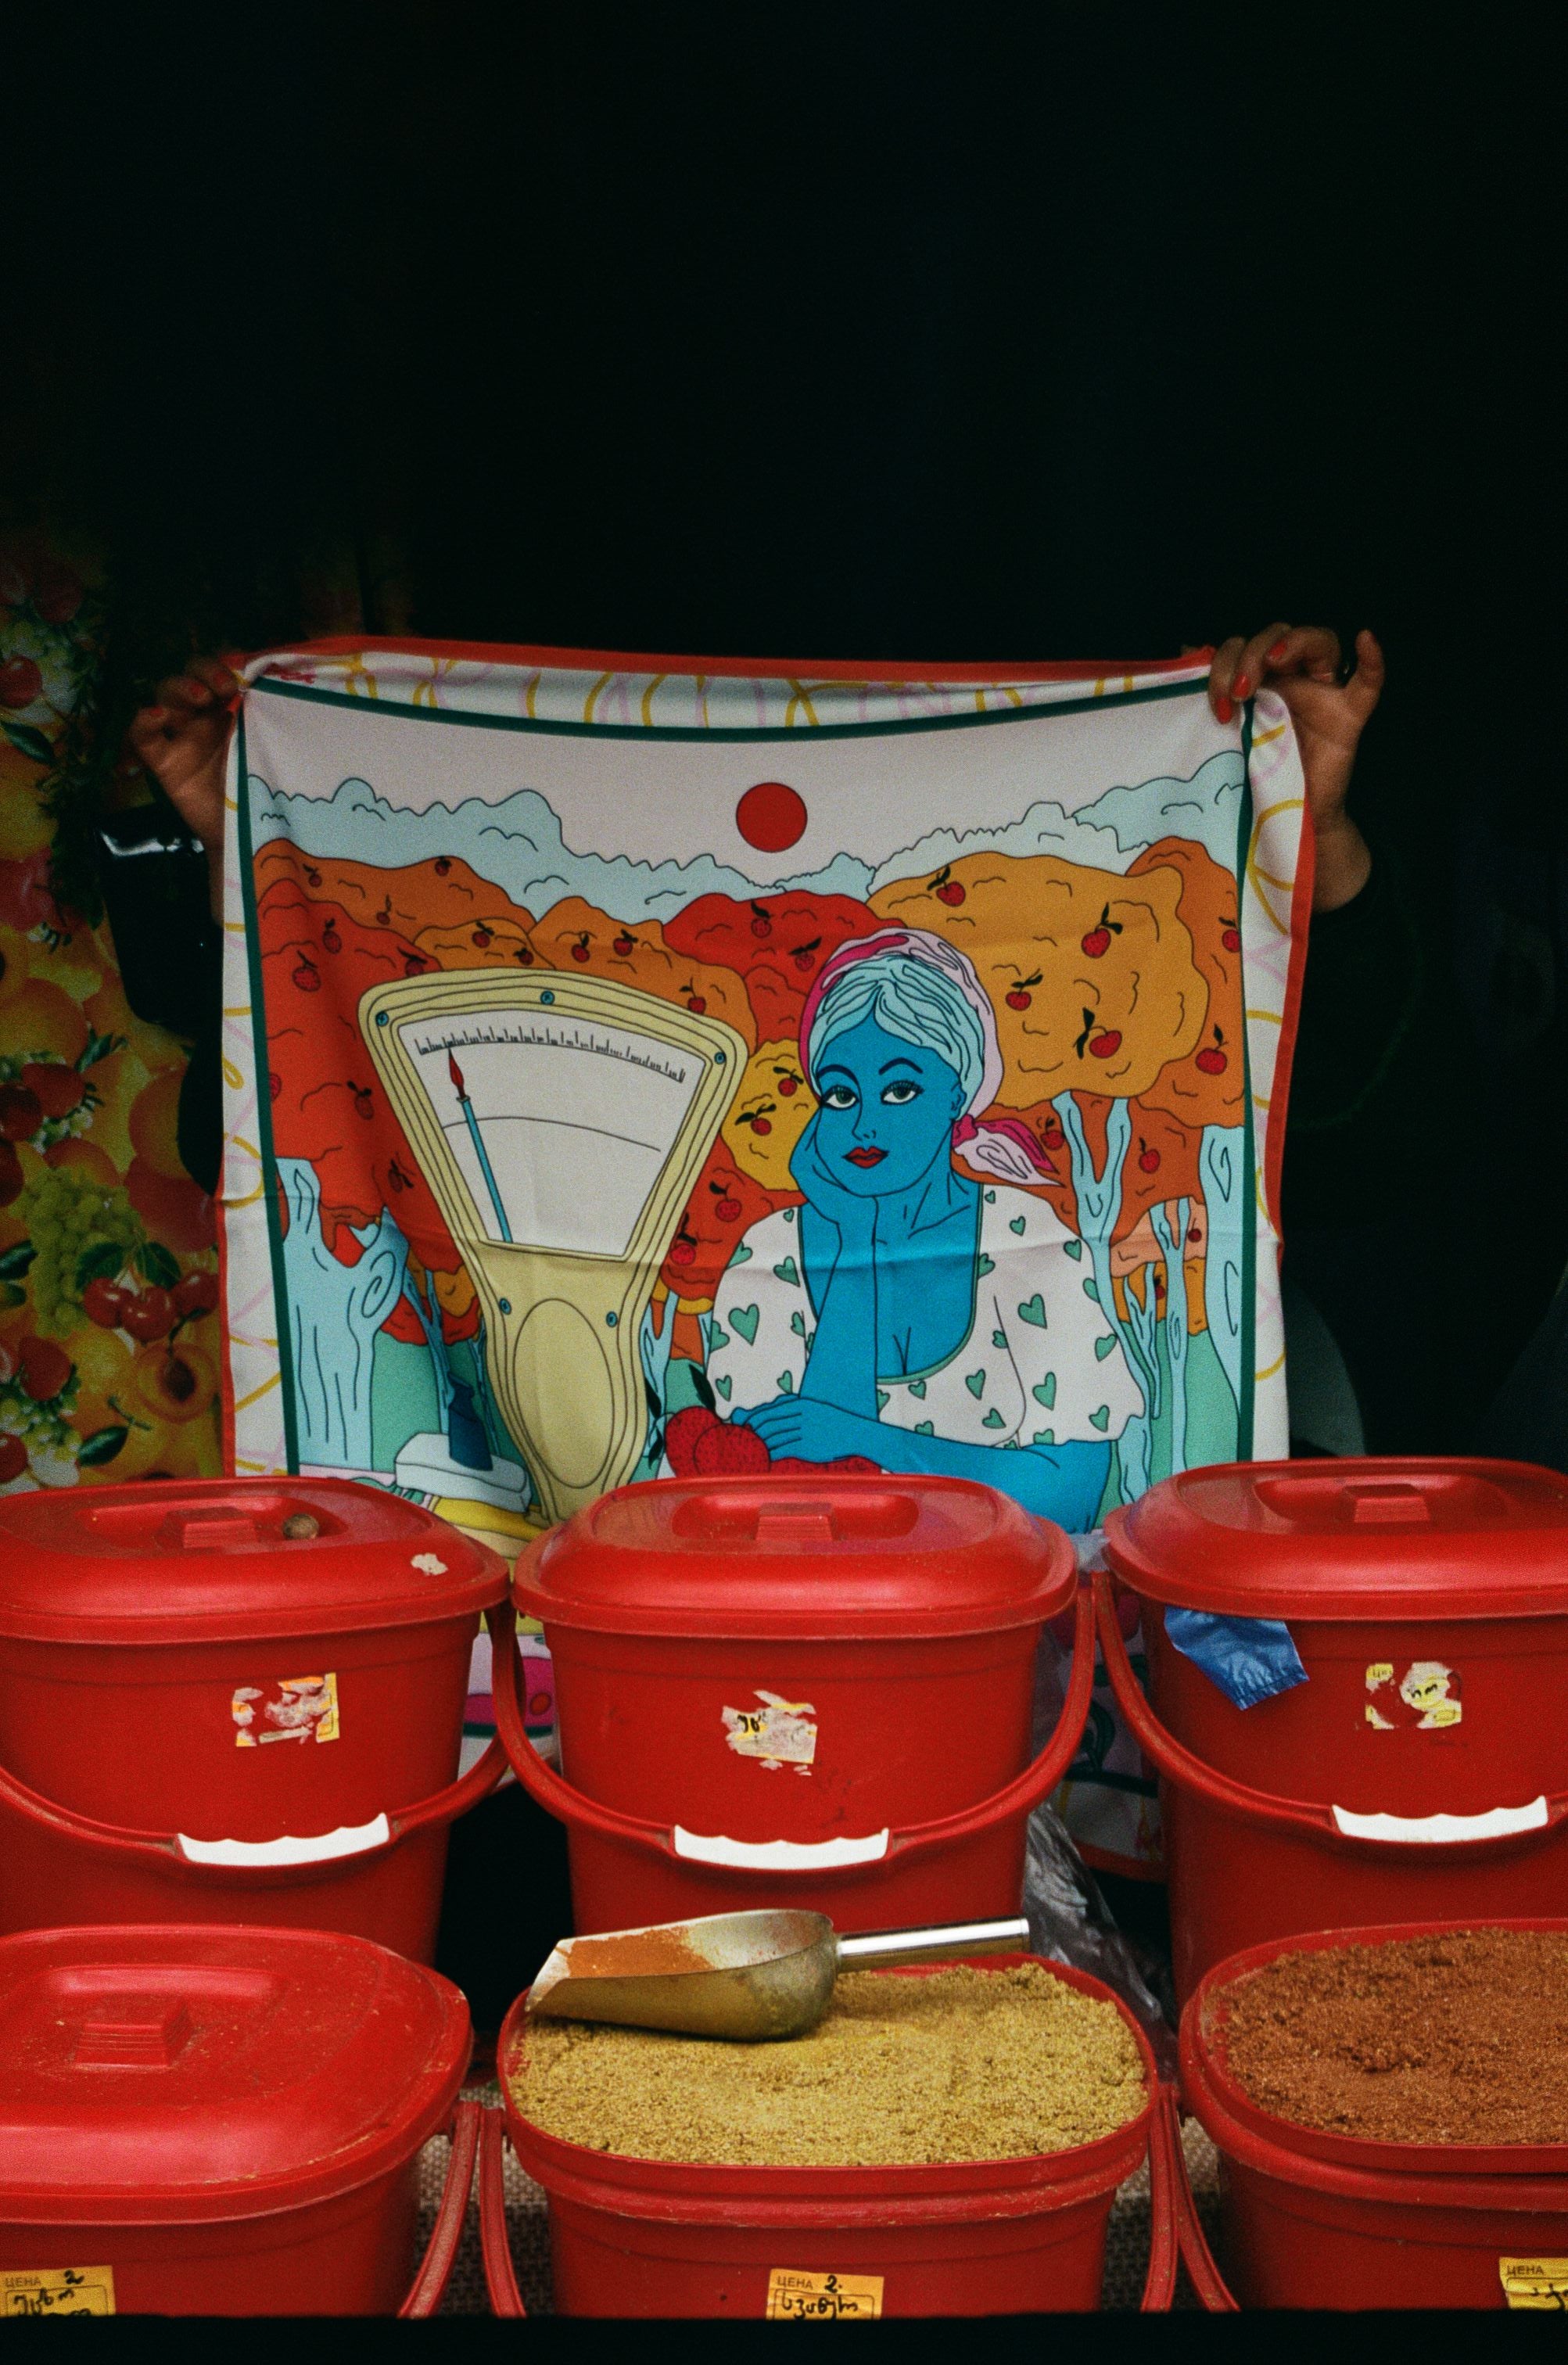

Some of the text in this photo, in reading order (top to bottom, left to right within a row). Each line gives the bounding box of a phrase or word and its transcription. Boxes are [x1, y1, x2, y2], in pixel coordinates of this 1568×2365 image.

[1506, 2265, 1545, 2277] ЦЕНА
[5, 2277, 41, 2288] ЦЕНА
[777, 2275, 814, 2290] ЦЕНА
